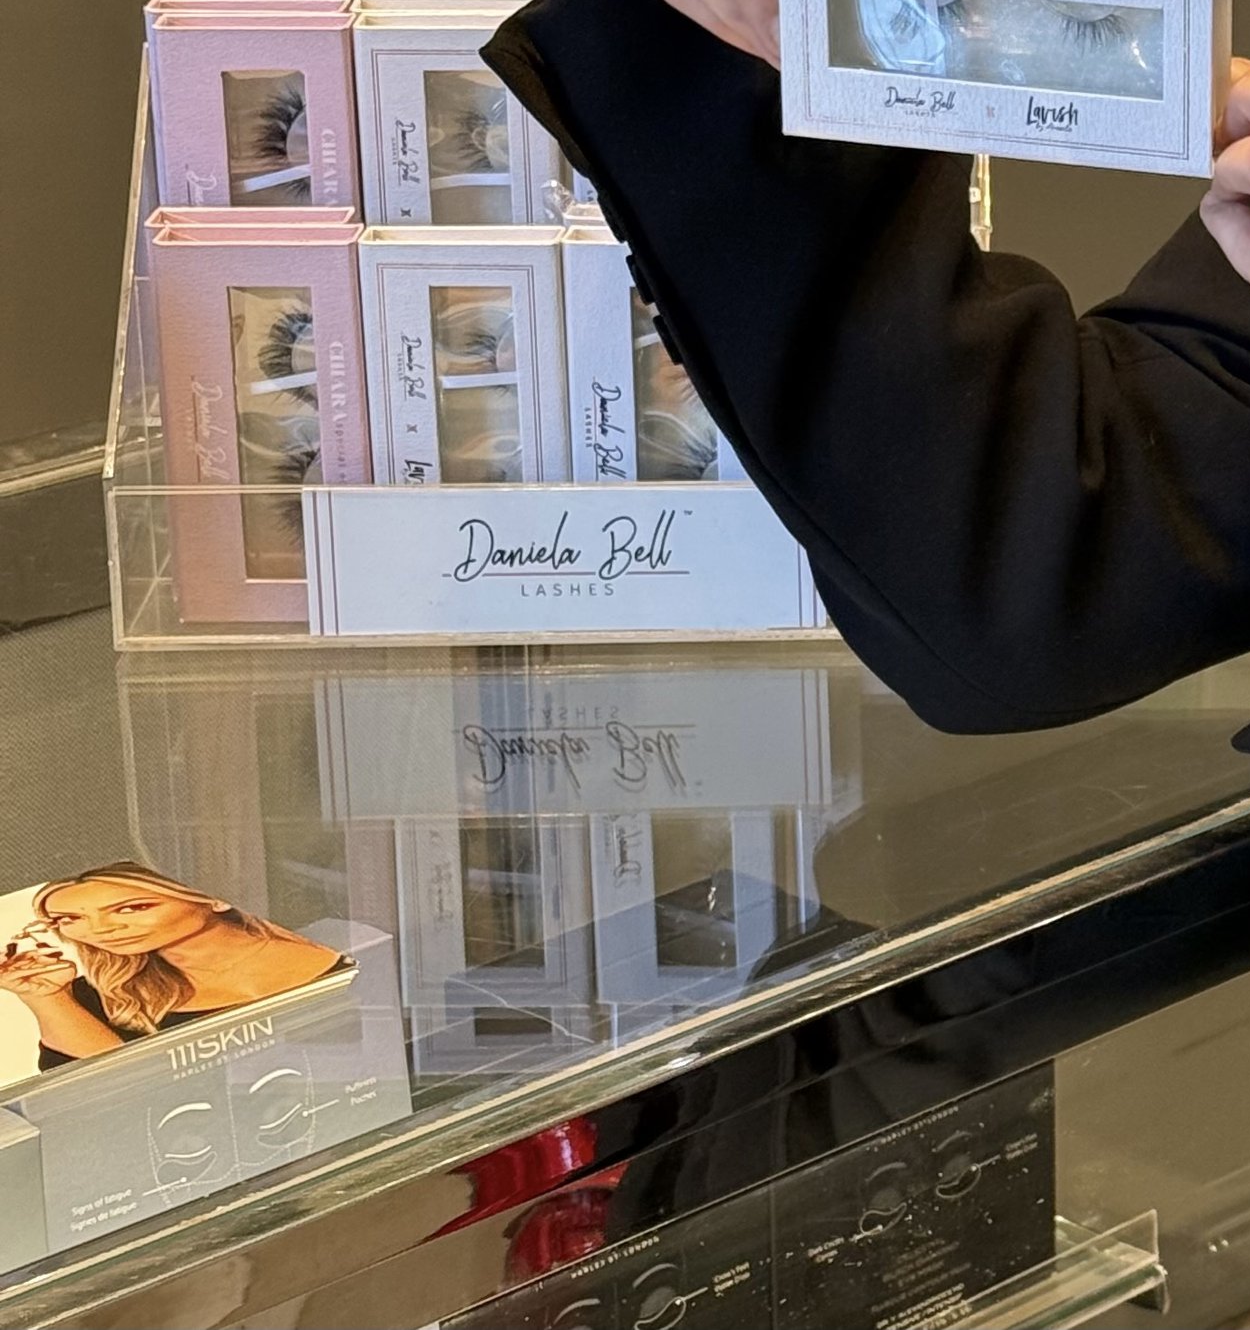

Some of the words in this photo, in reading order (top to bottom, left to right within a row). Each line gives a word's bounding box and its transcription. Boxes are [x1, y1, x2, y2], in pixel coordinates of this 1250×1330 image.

[1027, 96, 1078, 126] Lavish
[454, 511, 582, 582] Daniela
[598, 509, 676, 581] Bell
[520, 582, 616, 597] LASHES
[166, 1016, 274, 1071] 111SKIN
